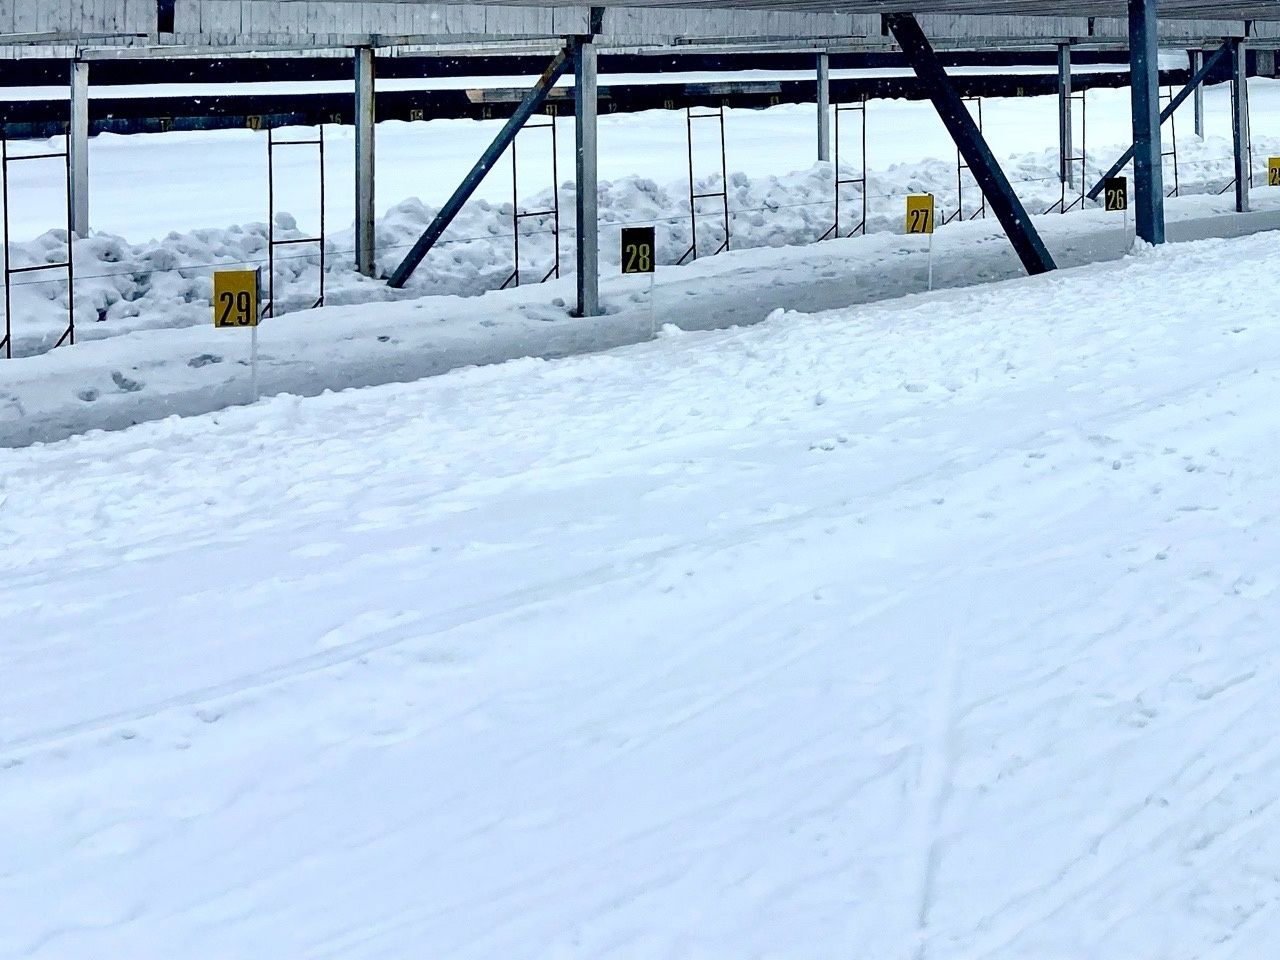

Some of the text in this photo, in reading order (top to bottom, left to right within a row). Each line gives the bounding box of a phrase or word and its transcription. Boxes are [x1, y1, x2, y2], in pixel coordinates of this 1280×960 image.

[1108, 189, 1124, 210] 26
[910, 209, 929, 233] 27
[626, 243, 650, 273] 28
[219, 290, 251, 327] 29
